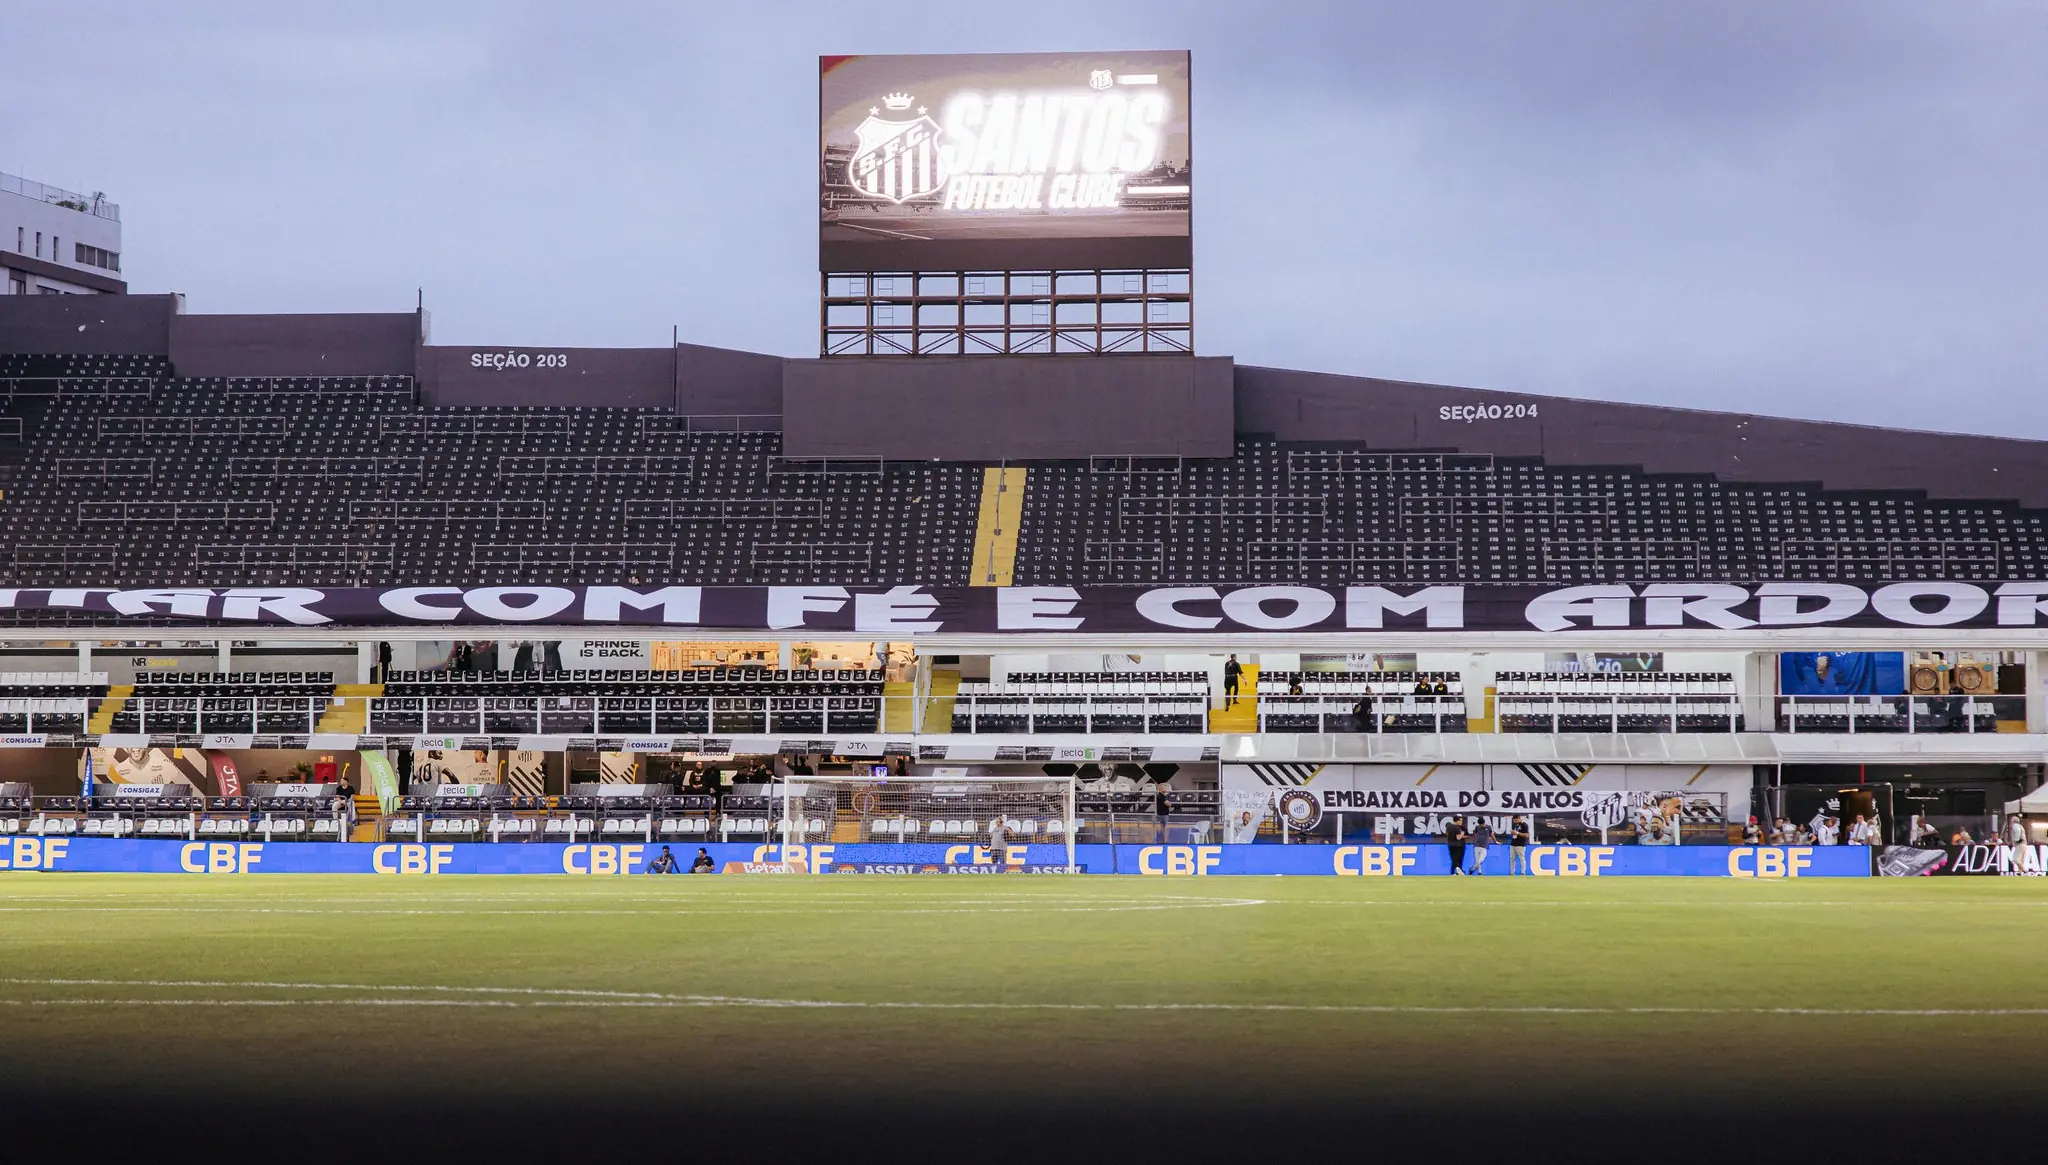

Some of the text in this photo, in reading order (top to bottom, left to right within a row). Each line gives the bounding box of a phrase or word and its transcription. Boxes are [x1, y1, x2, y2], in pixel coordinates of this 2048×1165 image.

[945, 91, 1168, 173] SANTOS
[943, 173, 1126, 210] FUTEBOL CLUBE
[470, 350, 568, 371] SEÇÃO 203
[1440, 402, 1539, 424] SEÇÃO 204
[0, 588, 334, 625] TAR
[380, 585, 702, 623] COM
[766, 584, 944, 632] FÉ
[997, 585, 1086, 629] E
[1136, 585, 1465, 629] COM
[579, 649, 644, 658] IS BACK.
[583, 640, 641, 648] PRINCE
[131, 657, 147, 667] NR
[215, 735, 235, 744] JTA
[421, 738, 444, 748] tecla
[847, 742, 868, 750] JTA
[1060, 748, 1084, 758] tecla
[222, 765, 238, 795] JTA
[418, 762, 432, 783] 10
[288, 785, 309, 793] JTA
[443, 785, 466, 795] tecla
[1323, 790, 1584, 809] EMBAIXADA DO SANTOS
[1374, 815, 1406, 835] EM
[180, 842, 264, 874] CBF
[373, 844, 455, 874] CBF
[562, 844, 644, 874] CBF
[1138, 845, 1222, 876] CBF
[1333, 846, 1418, 876] CBF
[1530, 846, 1615, 877] CBF
[1728, 847, 1813, 878] CBF
[1951, 845, 2048, 872] ADAMA
